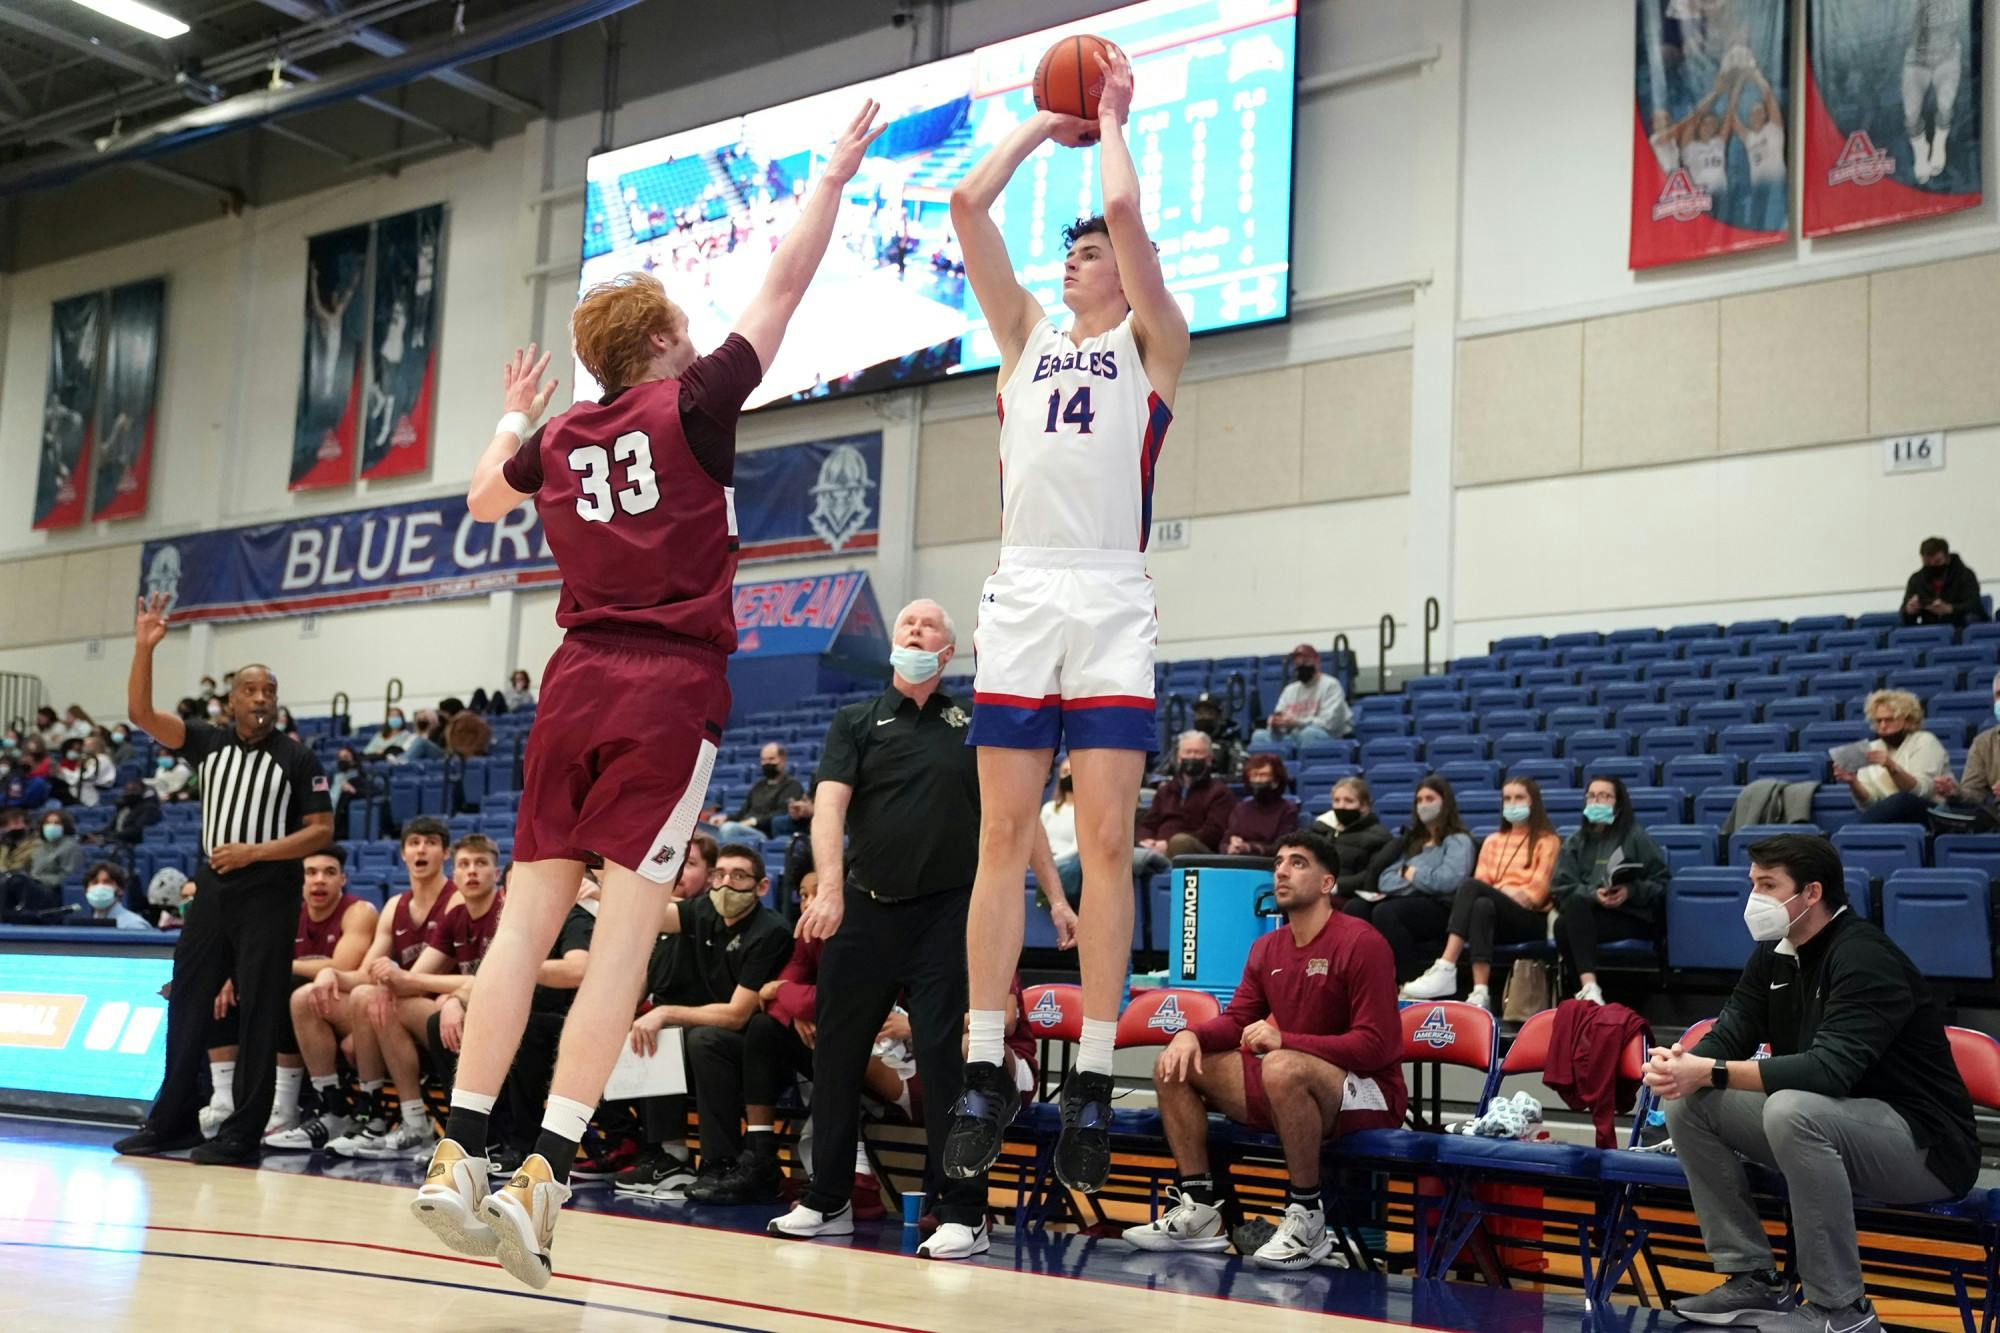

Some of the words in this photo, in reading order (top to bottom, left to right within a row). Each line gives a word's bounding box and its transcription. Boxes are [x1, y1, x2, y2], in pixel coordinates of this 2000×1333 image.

[1032, 351, 1118, 383] EAGLES
[1044, 386, 1095, 434] 14
[1894, 438, 1931, 462] 116
[567, 429, 661, 523] 33
[281, 510, 443, 590] BLUE
[453, 499, 554, 569] CR
[1158, 523, 1183, 541] 115
[732, 574, 859, 630] ERICAN
[1183, 875, 1198, 975] POWERADE
[1414, 1031, 1454, 1041] AMERICAN
